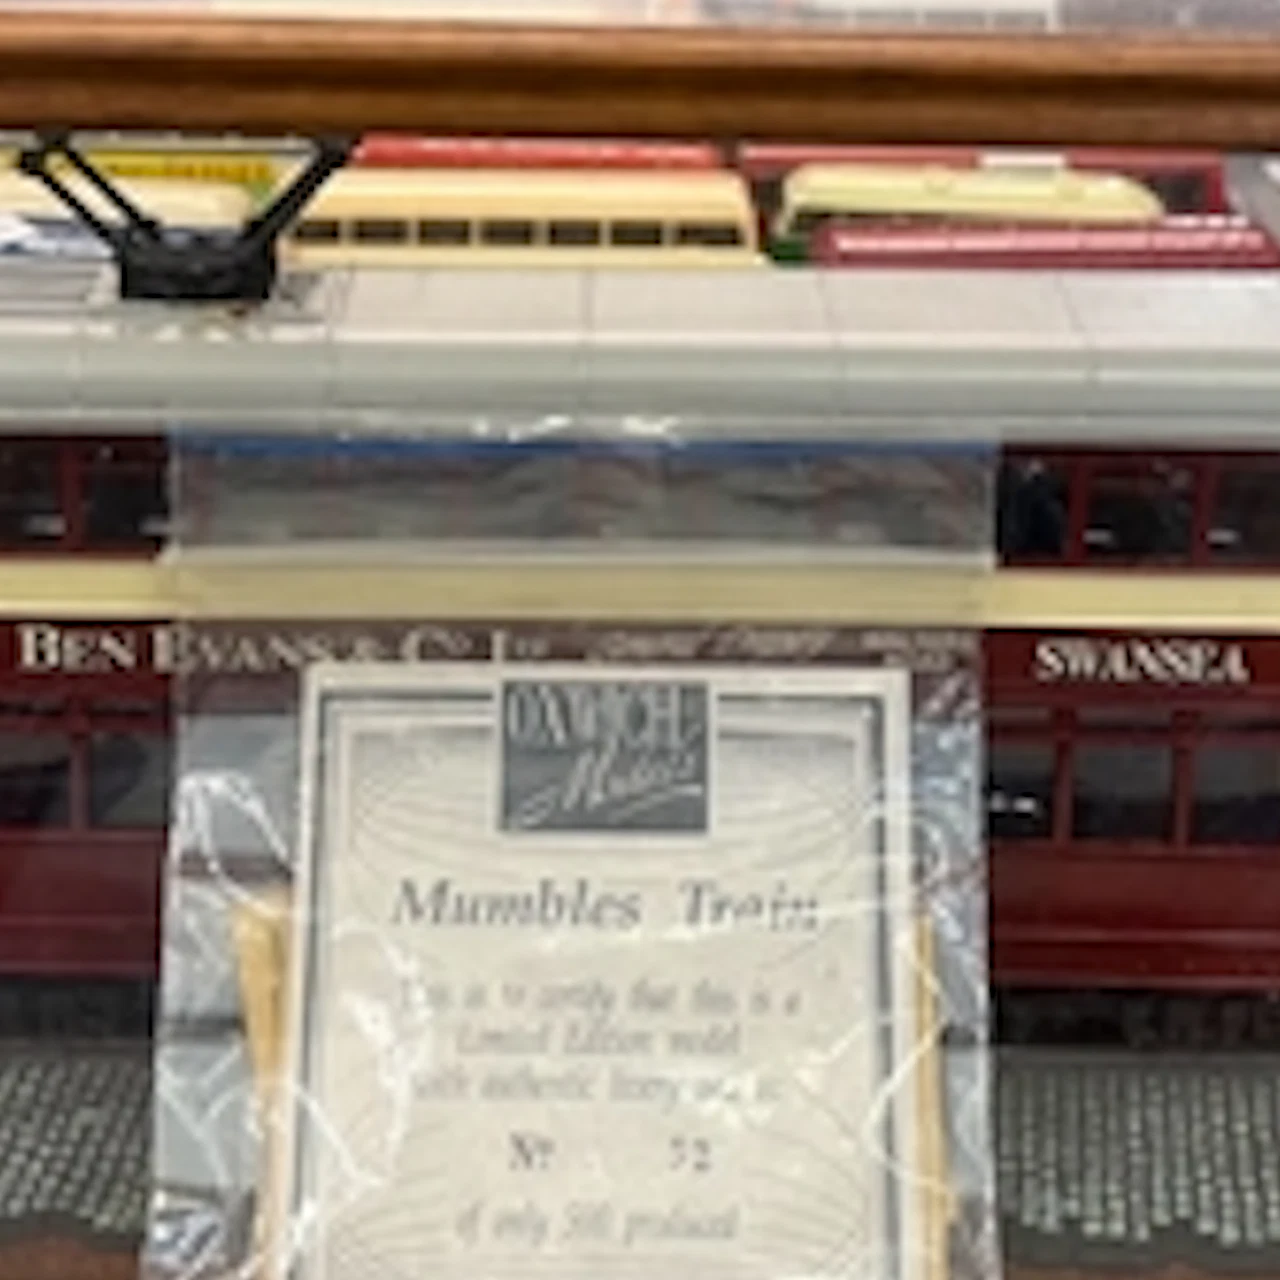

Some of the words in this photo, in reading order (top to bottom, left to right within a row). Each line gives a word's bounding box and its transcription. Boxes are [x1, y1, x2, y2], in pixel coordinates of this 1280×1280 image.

[16, 623, 137, 673] BEN
[1034, 635, 1252, 685] SWANSEA
[389, 877, 642, 927] Mumbles
[678, 878, 819, 932] Train
